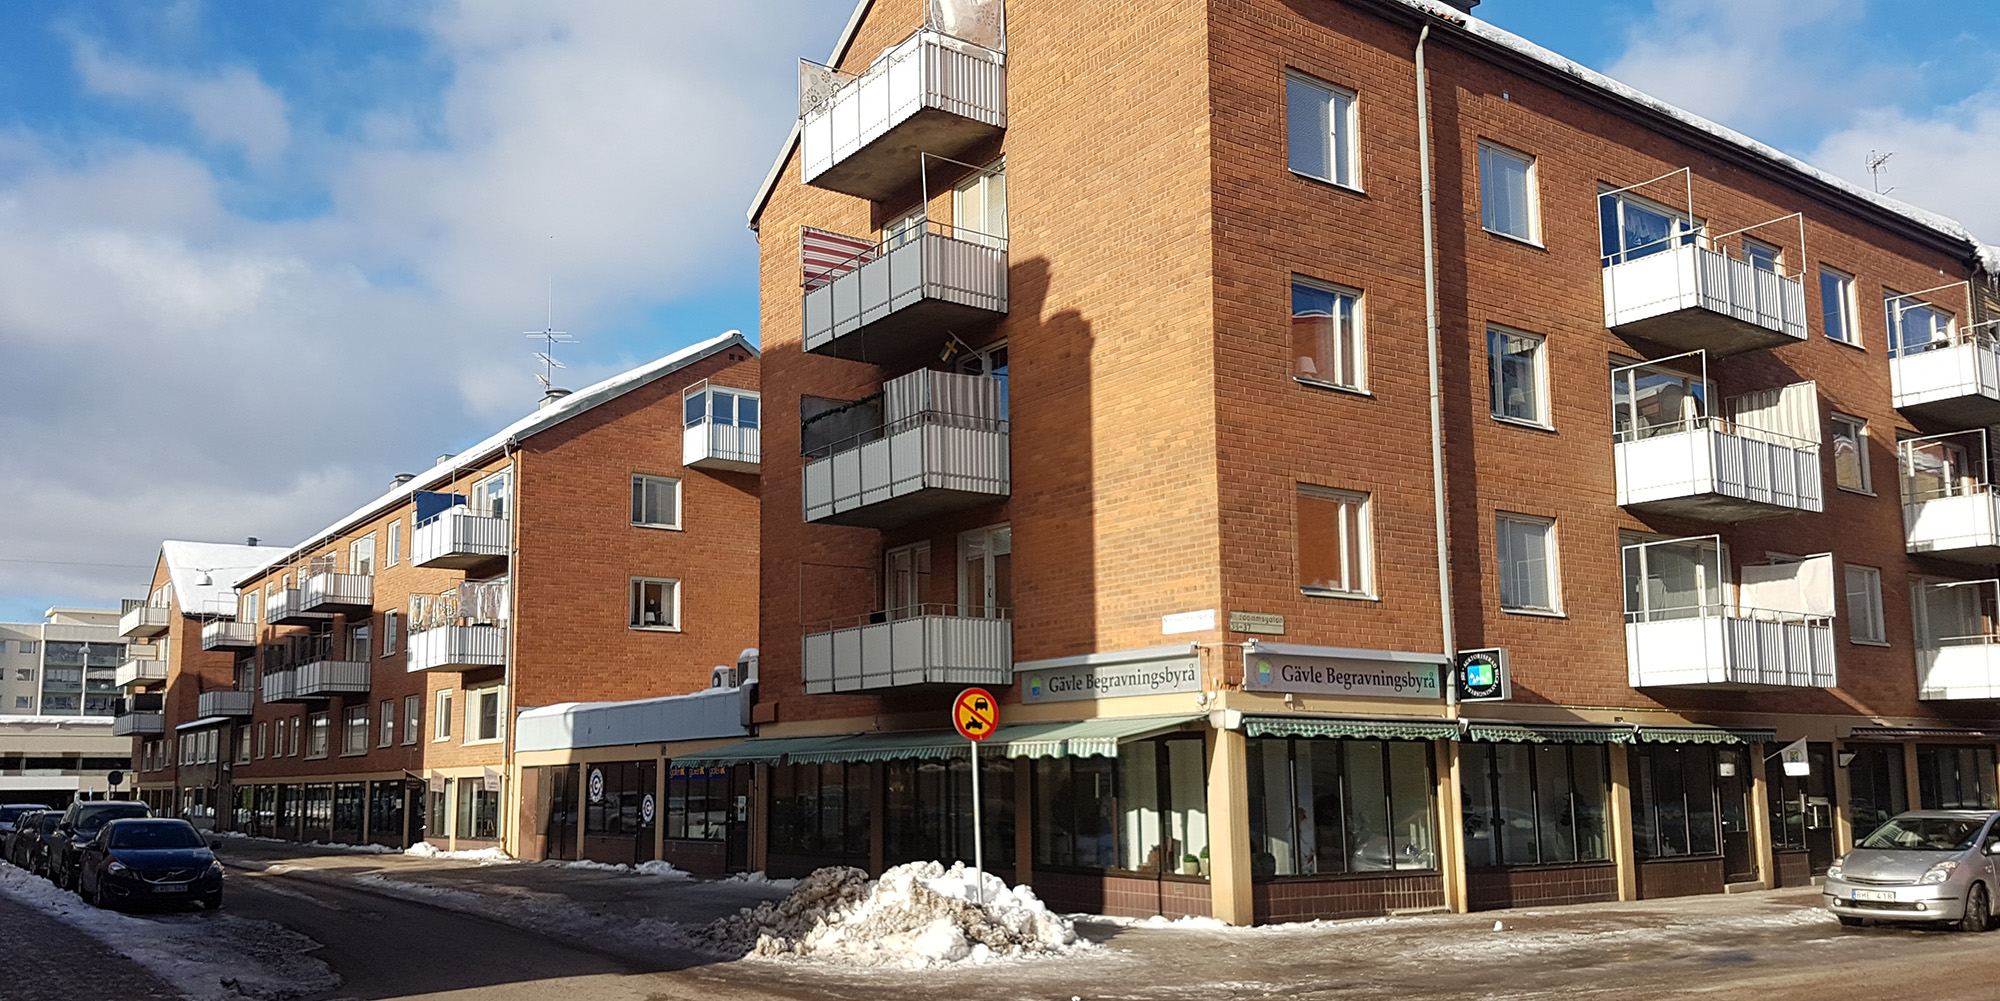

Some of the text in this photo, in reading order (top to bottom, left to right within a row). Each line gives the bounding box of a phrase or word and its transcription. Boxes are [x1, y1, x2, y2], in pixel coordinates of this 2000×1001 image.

[1048, 675, 1083, 693] Gävle
[1085, 663, 1196, 694] Begravningsbyrå
[1281, 664, 1323, 684] Gävle
[1325, 667, 1436, 694] Begravningsbyrå
